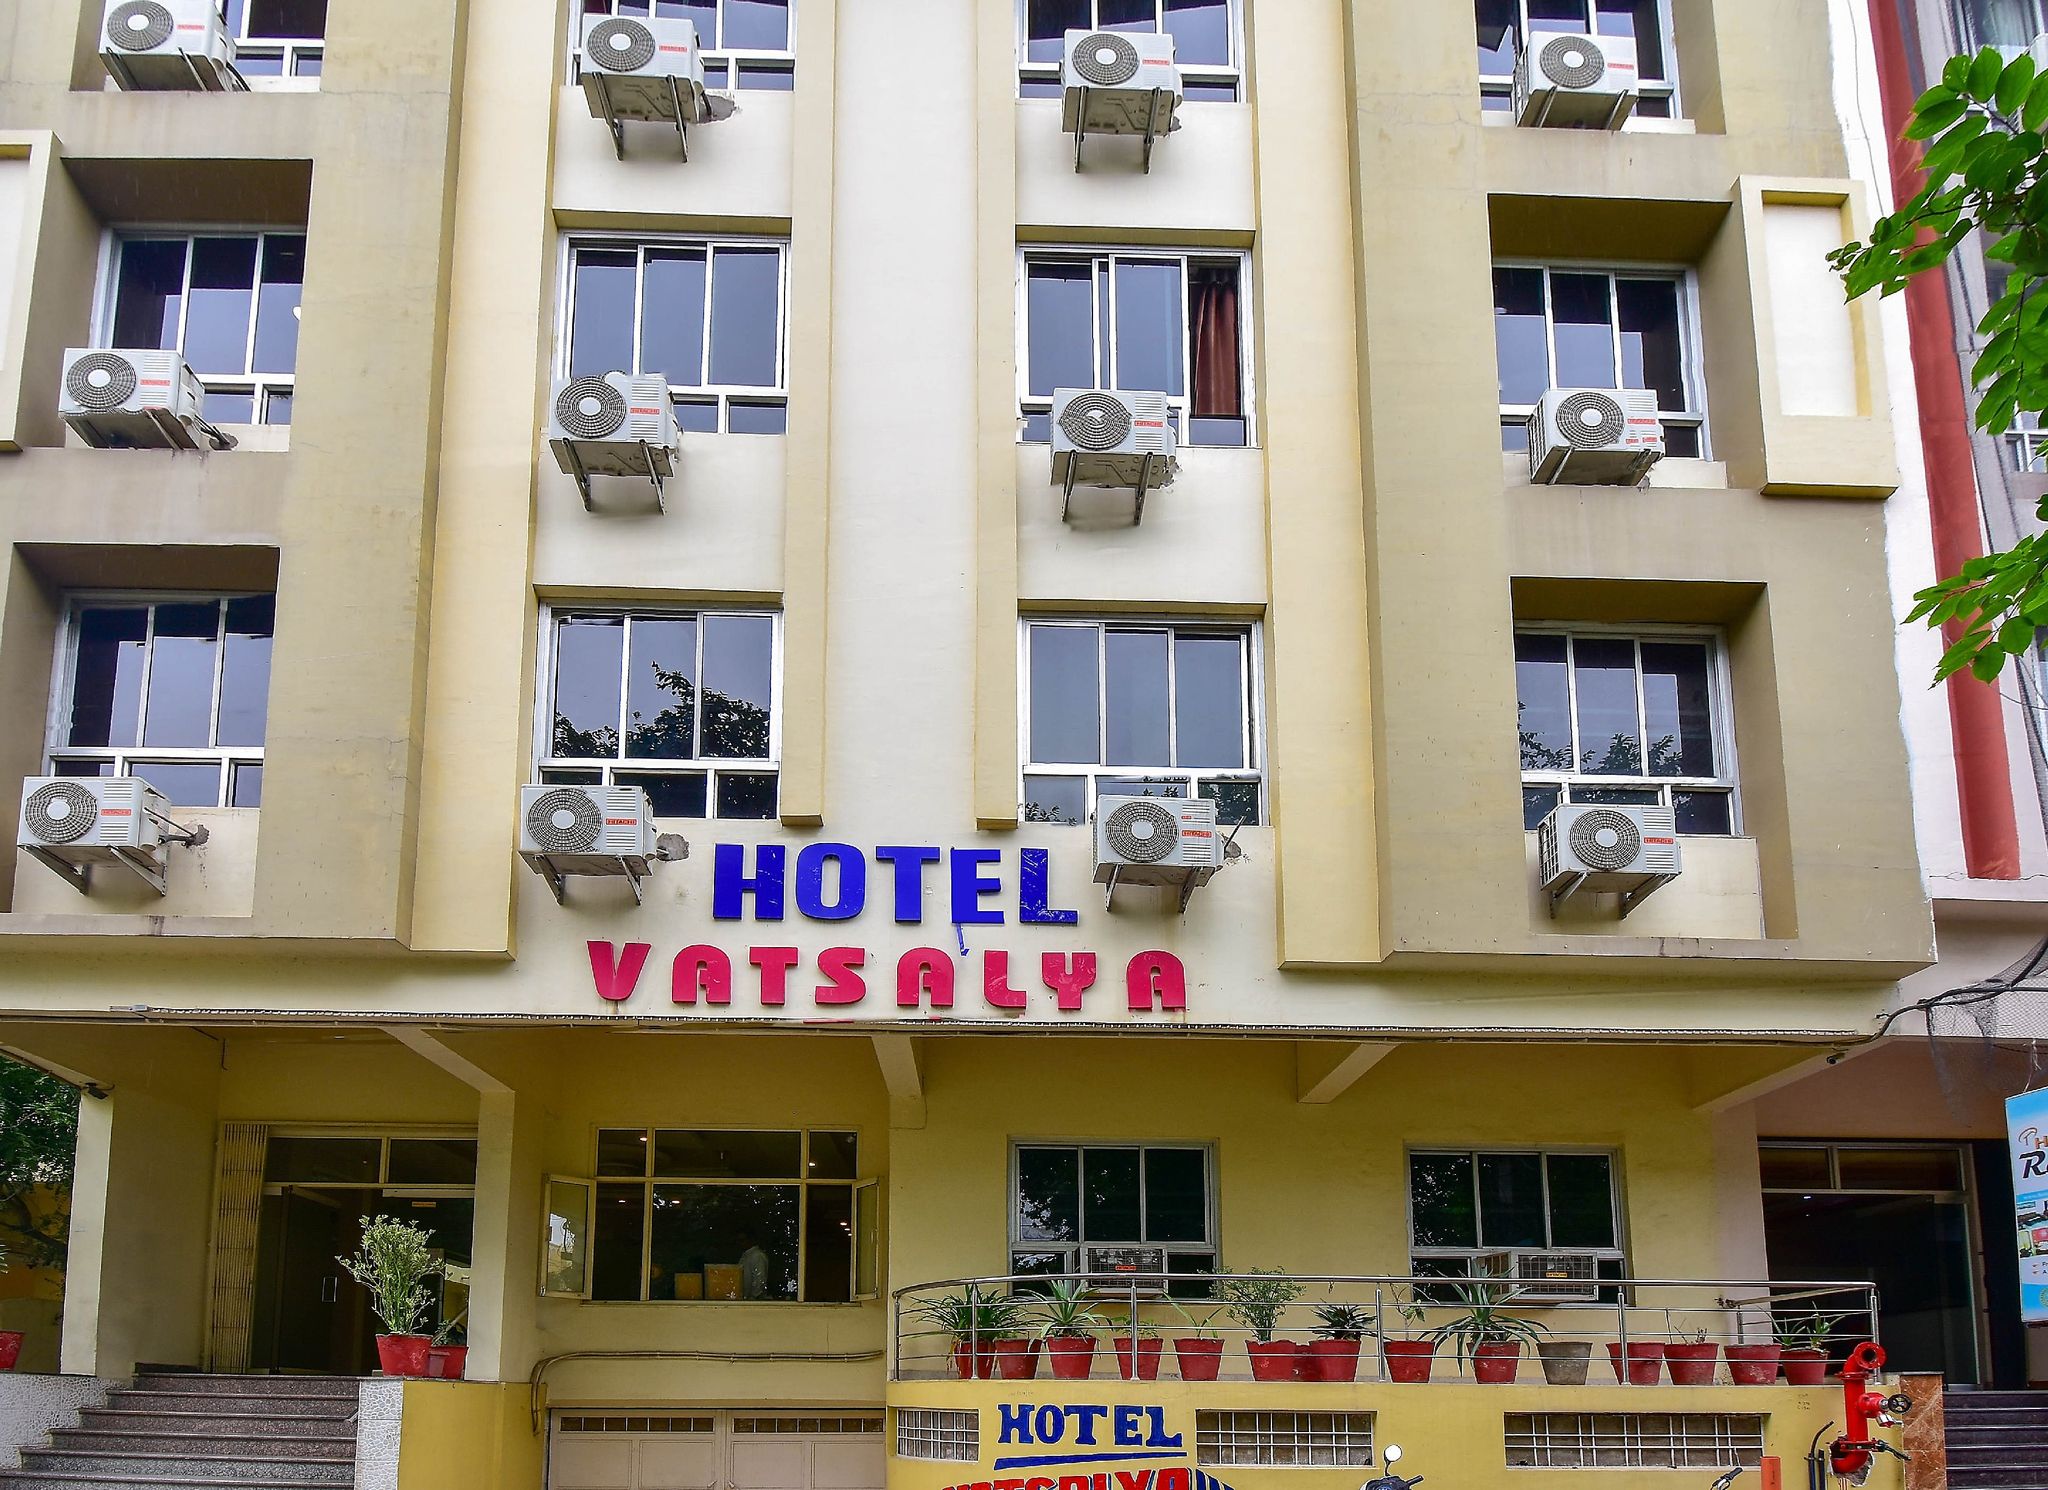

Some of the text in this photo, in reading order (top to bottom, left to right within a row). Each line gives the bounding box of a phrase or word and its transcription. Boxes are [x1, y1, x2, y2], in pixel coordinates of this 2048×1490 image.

[713, 843, 1078, 925] HOTEL
[587, 940, 1187, 1010] VATSALYA
[997, 1403, 1184, 1448] HOTEL
